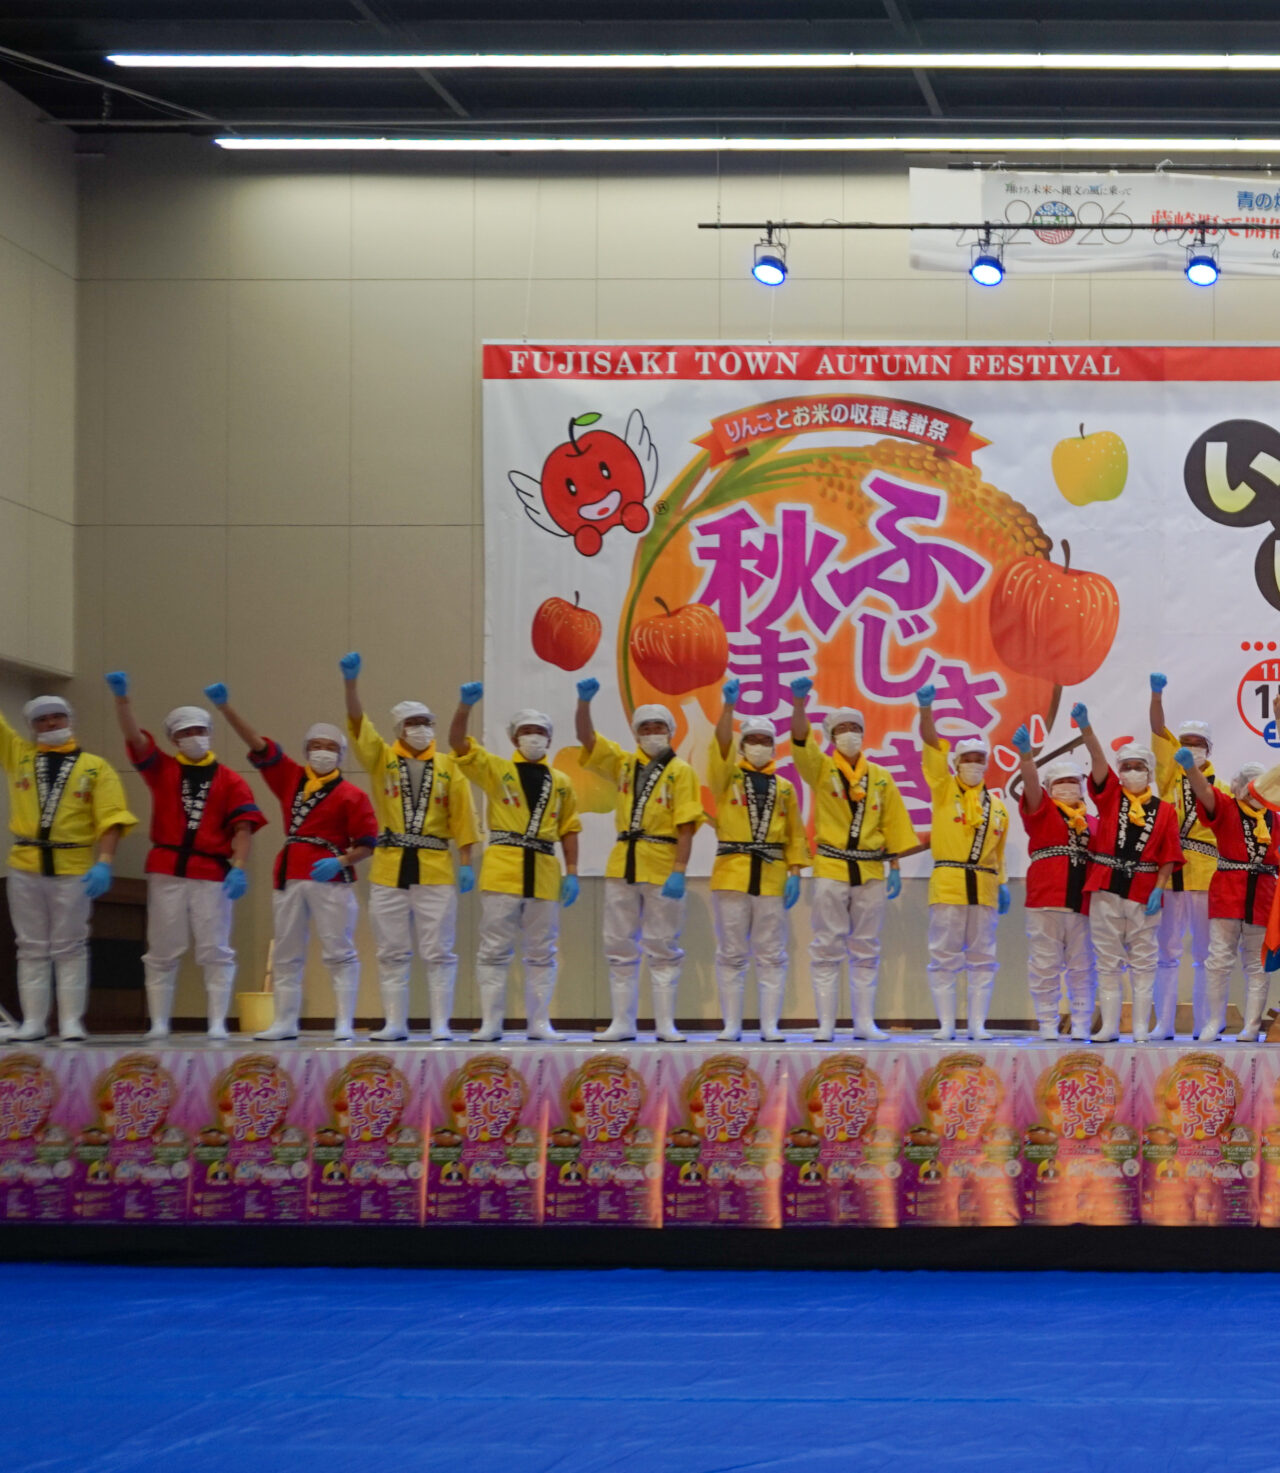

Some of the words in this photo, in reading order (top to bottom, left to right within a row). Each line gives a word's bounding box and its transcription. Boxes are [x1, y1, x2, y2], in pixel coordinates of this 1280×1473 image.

[509, 351, 678, 376] FUJISAKI
[694, 350, 800, 376] TOWN
[815, 353, 953, 377] AUTUMN
[966, 353, 1121, 377] FESTIVAL
[724, 401, 950, 444] りんごとお米の収穫感謝祭
